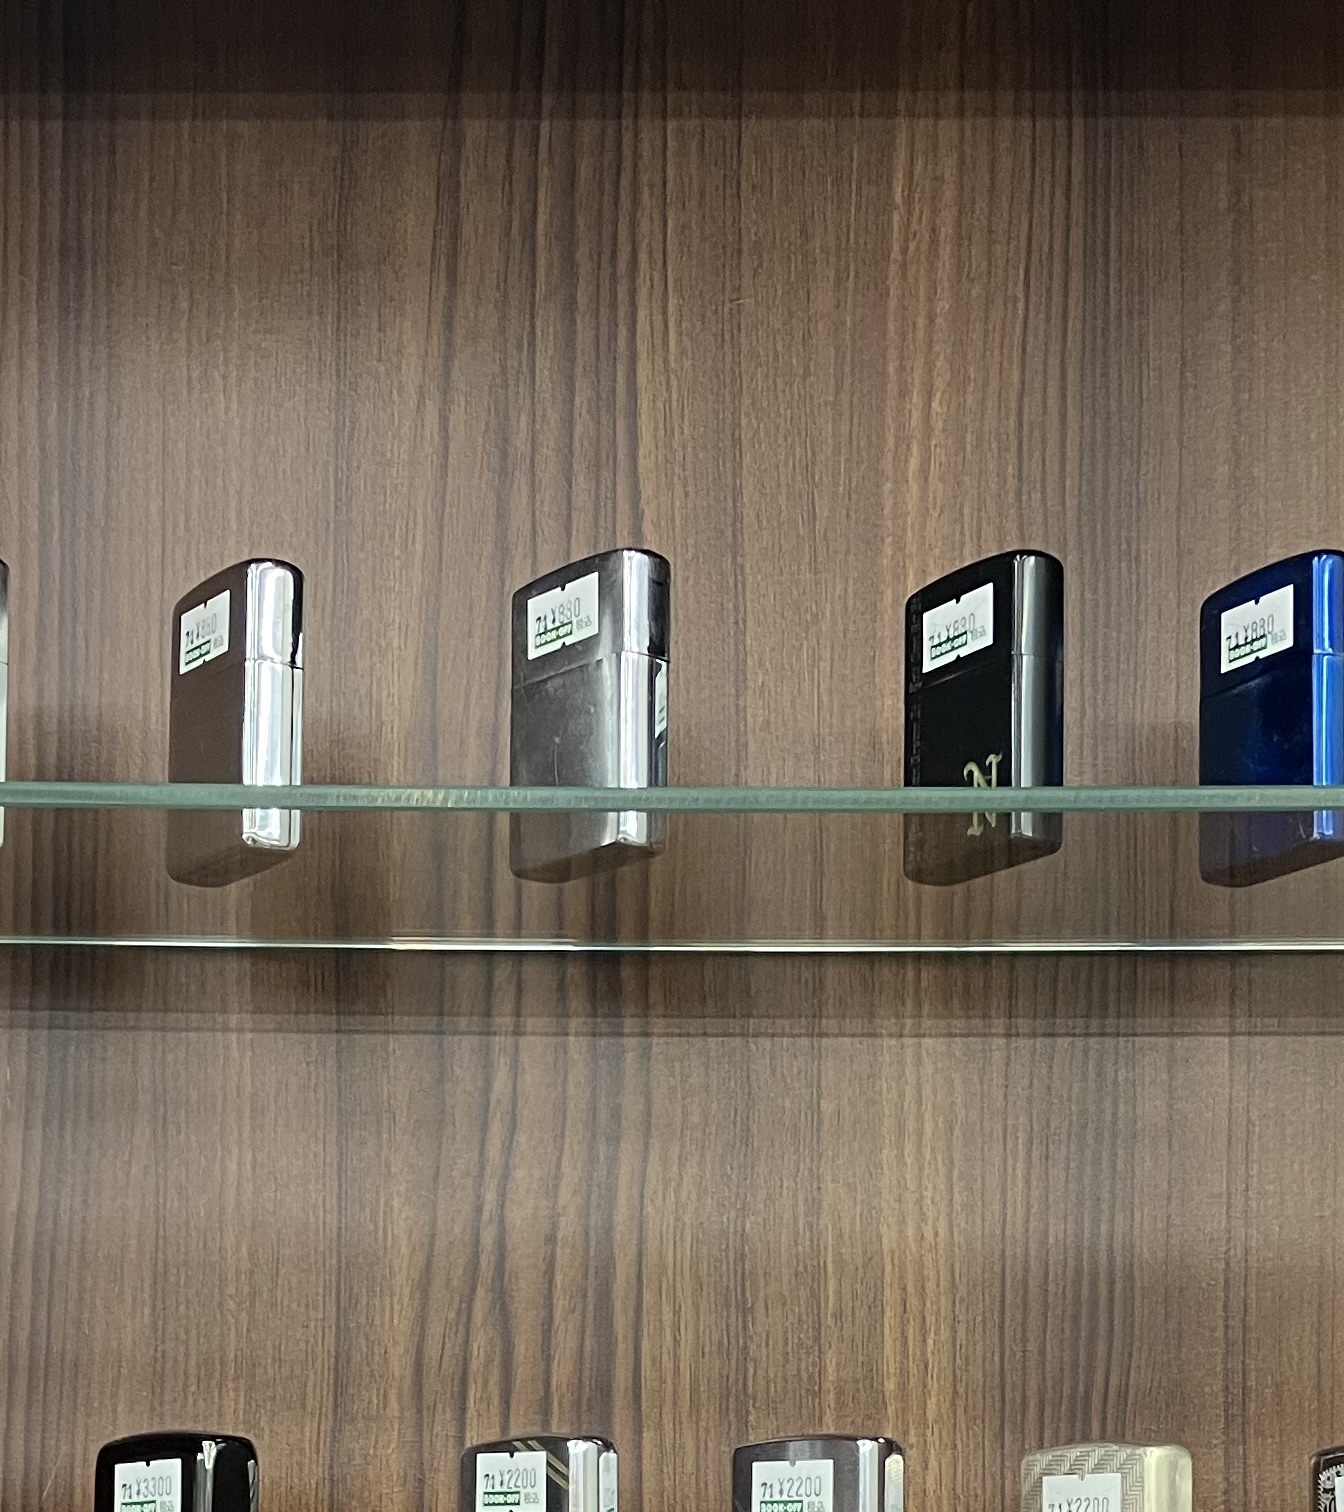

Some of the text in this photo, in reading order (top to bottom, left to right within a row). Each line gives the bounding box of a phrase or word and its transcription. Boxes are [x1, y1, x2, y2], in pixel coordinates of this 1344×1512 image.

[136, 1476, 172, 1498] ¥3300
[499, 1468, 536, 1490] ¥2200
[778, 1475, 821, 1498] ¥2200
